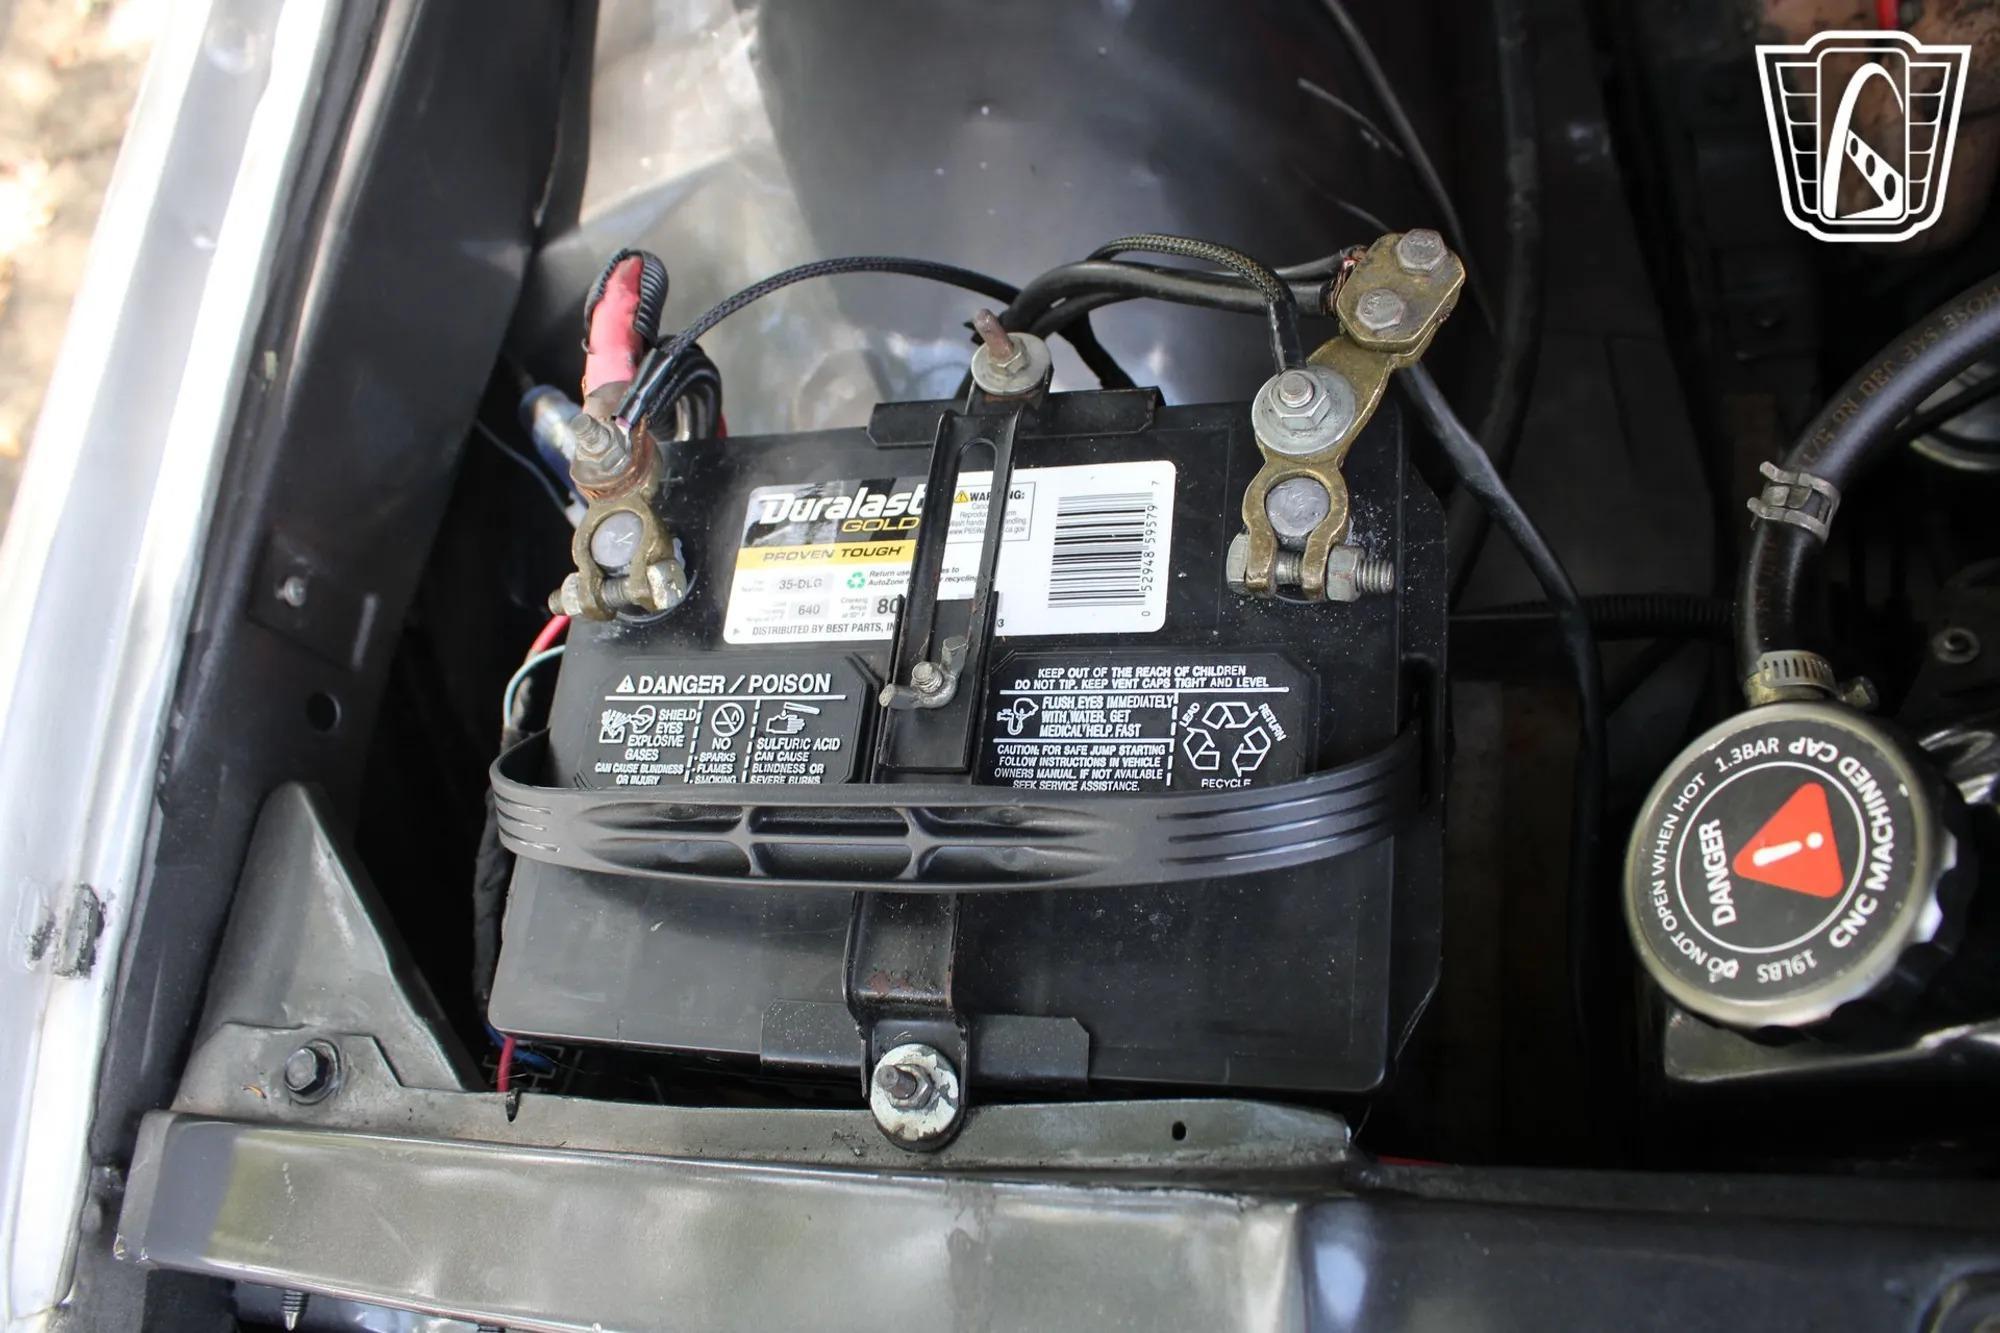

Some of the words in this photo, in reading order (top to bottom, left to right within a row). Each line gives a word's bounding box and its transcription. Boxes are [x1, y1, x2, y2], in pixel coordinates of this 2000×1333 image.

[758, 483, 927, 525] Duralast
[841, 517, 921, 533] GOLD
[1145, 505, 1158, 544] 59579
[762, 549, 835, 562] PROVEN
[841, 546, 902, 558] TOUGH
[869, 570, 896, 578] Return
[1141, 551, 1155, 592] 52948
[778, 578, 823, 590] 35-DLG
[868, 578, 905, 586] AutoZone
[797, 604, 821, 616] 640
[876, 598, 899, 615] 80
[752, 625, 809, 636] DISTRIBUTED
[812, 624, 824, 634] BY
[826, 624, 849, 633] BEST
[851, 623, 883, 634] PARTS,
[884, 622, 895, 632] IN
[1037, 667, 1065, 679] KEEP
[1067, 667, 1091, 678] OUT
[1092, 666, 1109, 678] OF
[1111, 666, 1134, 678] THE
[1135, 666, 1172, 677] REACH
[1173, 666, 1191, 677] OF
[1192, 665, 1247, 676] CHILDREN
[638, 674, 726, 694] DANGER
[748, 673, 832, 693] POISON
[1014, 679, 1032, 690] DO
[1033, 679, 1057, 690] NOT
[1059, 679, 1079, 690] TIP.
[1081, 678, 1109, 690] KEEP
[1111, 678, 1140, 689] VENT
[1141, 678, 1171, 688] CAPS
[1174, 677, 1208, 688] TIGHT
[1209, 677, 1233, 688] AND
[1236, 676, 1270, 688] LEVEL
[1041, 695, 1076, 710] FLUSH
[1077, 695, 1104, 709] EYES
[1106, 694, 1175, 709] IMMEDIATELY
[658, 708, 698, 721] SHIELD
[1041, 710, 1068, 724] WITH
[1109, 709, 1132, 723] GET
[1178, 702, 1201, 728] LEAD
[655, 721, 684, 734] EYES
[1258, 702, 1288, 742] RETURN
[1039, 724, 1084, 738] MEDICAL
[1114, 723, 1142, 737] FAST
[627, 734, 686, 748] EXPLOSIVE
[711, 737, 732, 750] NO
[756, 737, 812, 750] SULFURIC
[812, 737, 842, 751] ACID
[624, 748, 660, 761] GASES
[754, 751, 775, 762] CAN
[776, 751, 810, 762] CAUSE
[996, 744, 1040, 756] CAUTION:
[1041, 744, 1062, 756] FOR
[1063, 744, 1089, 756] SAFE
[1089, 744, 1117, 756] JUMP
[1117, 744, 1166, 756] STARTING
[1714, 737, 1780, 774] 1.3BAR
[1788, 736, 1839, 763] CAP
[699, 752, 737, 763] SPARKS
[999, 756, 1038, 767] FOLLOW
[1039, 756, 1108, 768] INSTRUCTIONS
[1109, 756, 1120, 767] IN
[1122, 756, 1162, 767] VEHICLE
[594, 762, 613, 774] CAN
[612, 762, 640, 774] CAUSE
[640, 763, 685, 775] BLINDNESS
[697, 763, 734, 774] FLAMES
[752, 763, 806, 774] BLINDNESS
[809, 763, 825, 774] OR
[994, 767, 1034, 779] OWNERS
[1079, 768, 1090, 780] IF
[1091, 769, 1113, 780] NOT
[1113, 768, 1164, 780] AVAILABLE
[615, 774, 630, 786] OR
[630, 774, 661, 786] INJURY
[694, 775, 738, 785] SMOKING
[750, 775, 787, 785] SEVERE
[788, 775, 821, 785] BURNS
[1012, 780, 1038, 790] SEEK
[1039, 780, 1079, 791] SERVICE
[1080, 780, 1141, 792] ASSISTANCE.
[1201, 778, 1252, 789] RECYCLE
[1676, 772, 1706, 813] HOT
[1838, 756, 1895, 892] MACHINED
[1651, 812, 1681, 877] WHEN
[1698, 818, 1738, 928] DANGER
[1651, 880, 1678, 932] OPEN
[1828, 894, 1879, 949] CNC
[1670, 931, 1709, 966] NOT
[1756, 949, 1818, 984] 19LBS
